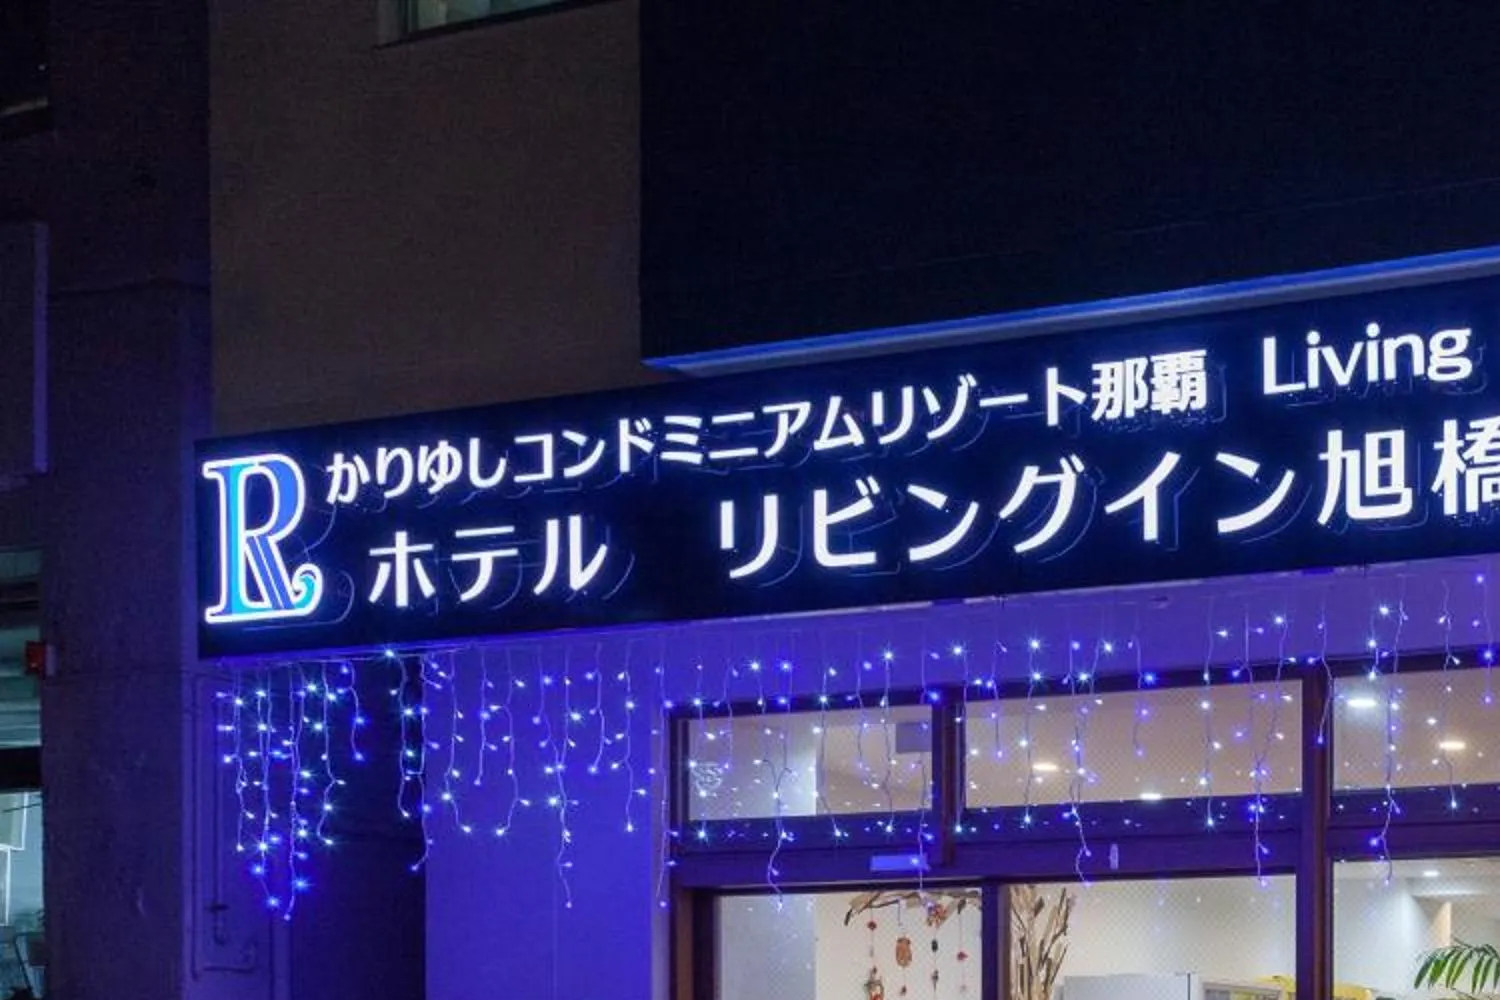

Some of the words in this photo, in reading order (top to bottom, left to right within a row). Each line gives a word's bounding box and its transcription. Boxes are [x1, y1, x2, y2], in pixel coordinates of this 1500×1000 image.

[1263, 322, 1472, 395] Living
[325, 349, 1208, 505] かりゆしコンドミニアムリゾート那覇
[203, 453, 323, 624] R
[369, 515, 608, 607] ホテル
